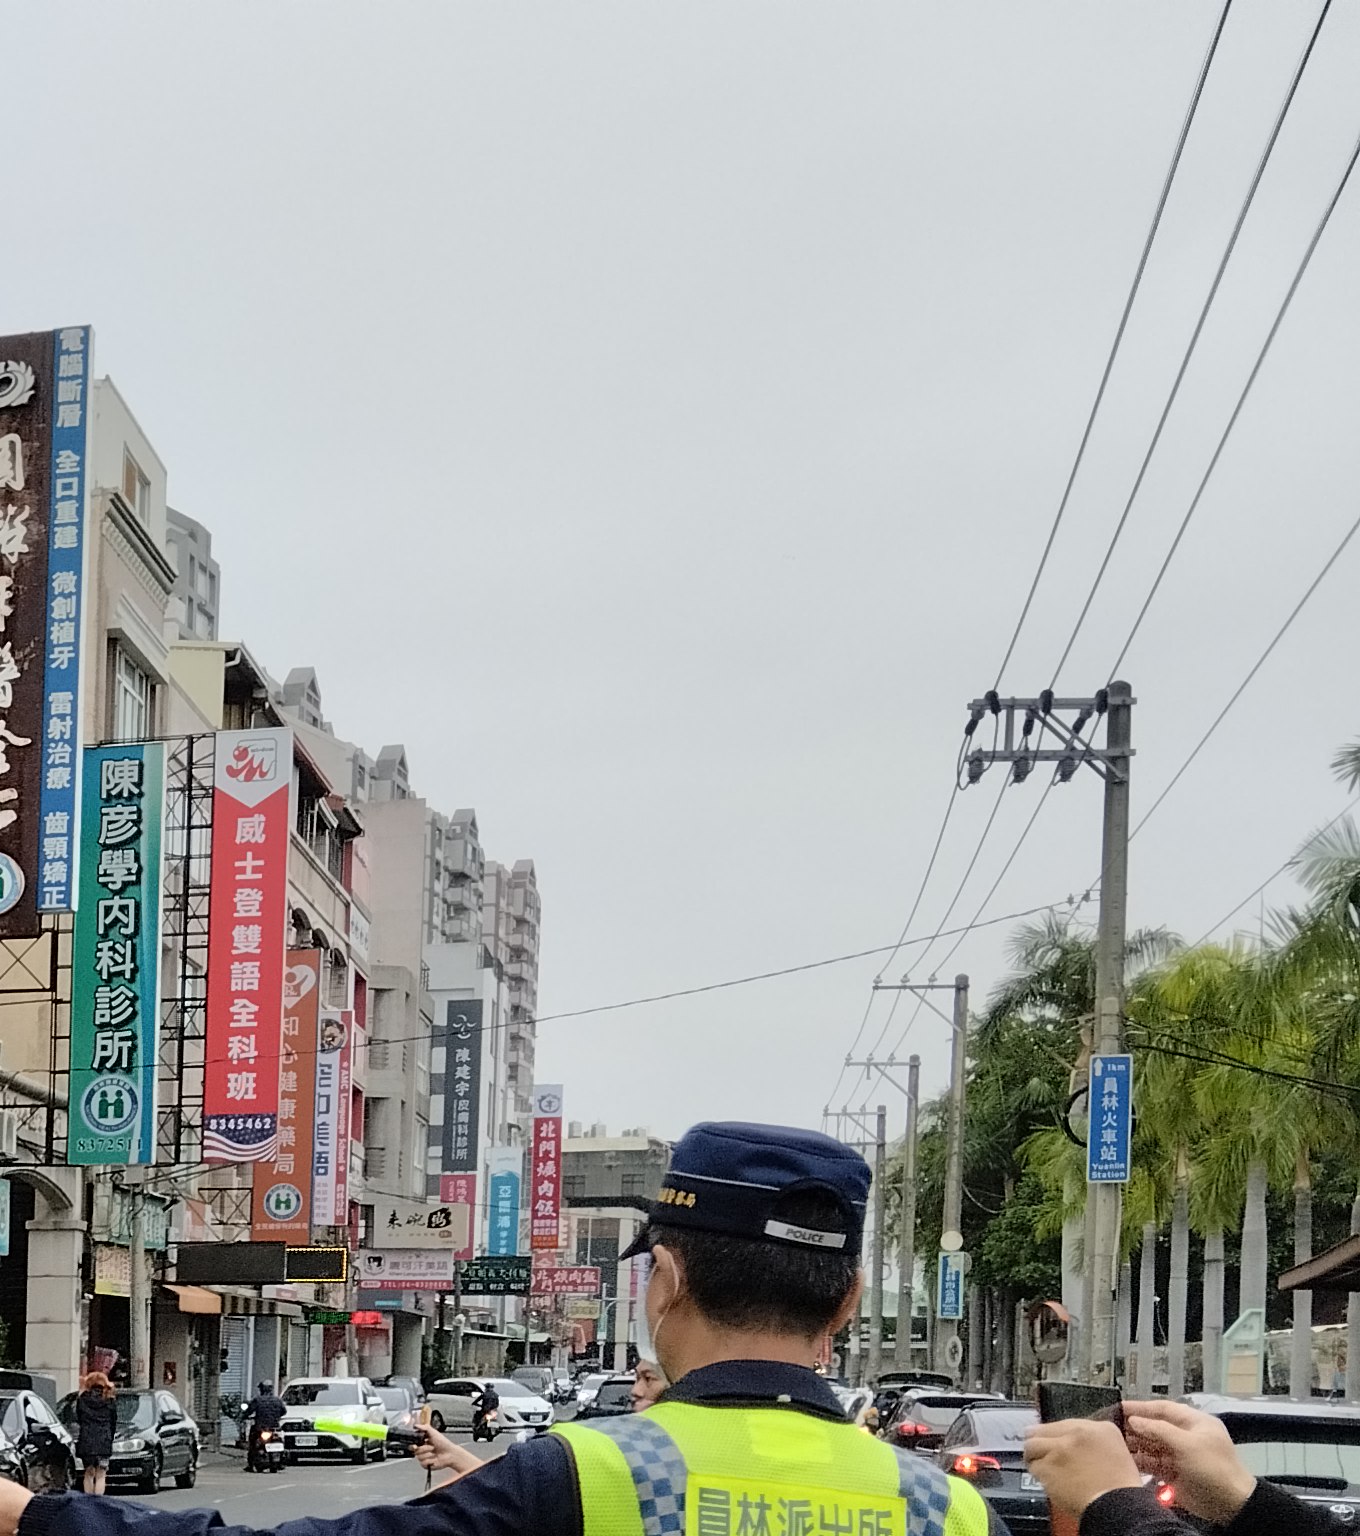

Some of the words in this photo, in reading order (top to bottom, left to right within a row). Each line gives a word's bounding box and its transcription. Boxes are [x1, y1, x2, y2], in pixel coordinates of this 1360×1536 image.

[56, 328, 84, 428] 電腦斷層
[53, 449, 80, 549] 全口重建
[49, 570, 77, 670] 微創植牙
[45, 691, 74, 790] 雷射治療
[41, 811, 70, 910] 齒顎矯正
[92, 758, 143, 1069] 陳彥學內科診所
[226, 813, 266, 1101] 威士登雙語全科班
[209, 1116, 272, 1131] 8345462
[1100, 1077, 1119, 1161] 員林火車站
[1091, 1170, 1126, 1180] Station
[785, 1228, 826, 1244] POLICE
